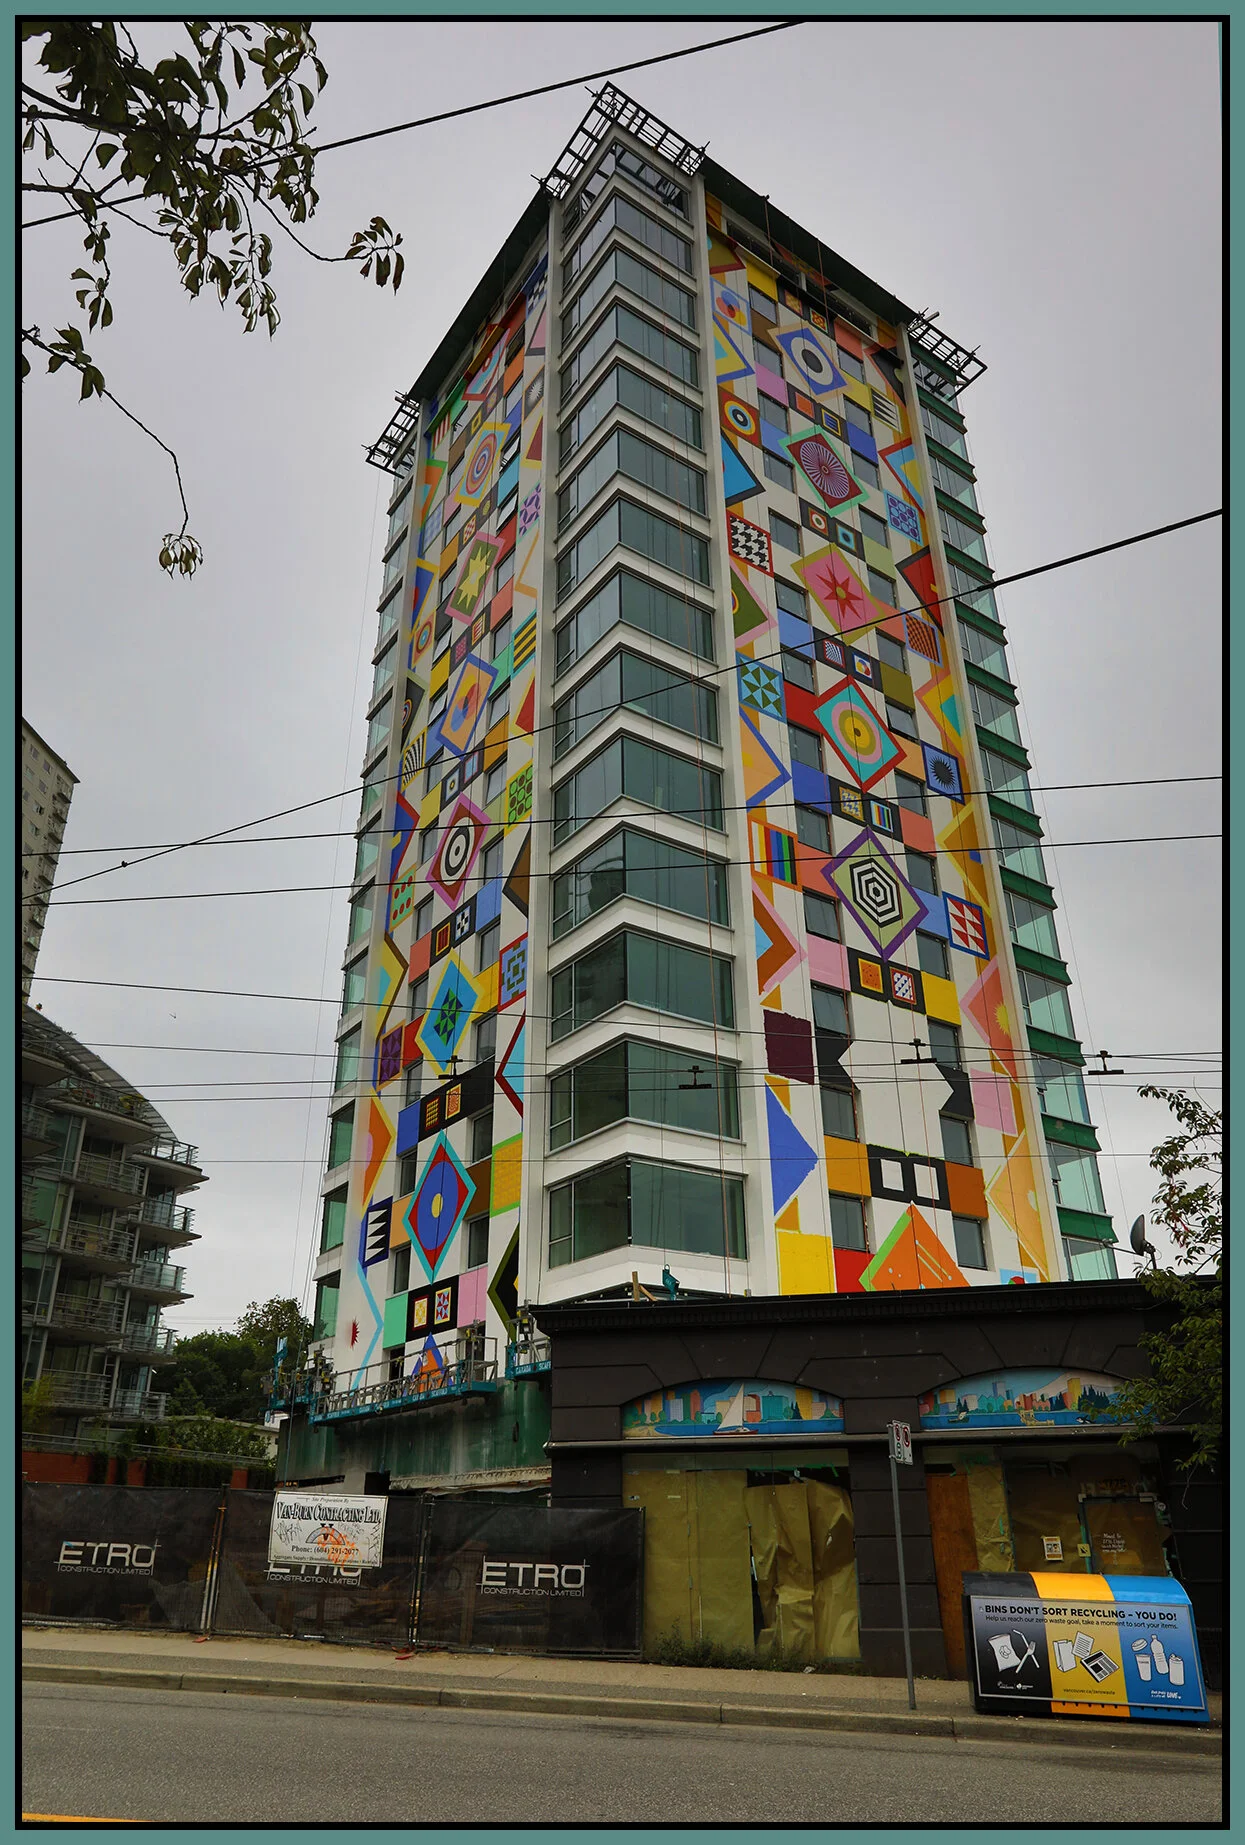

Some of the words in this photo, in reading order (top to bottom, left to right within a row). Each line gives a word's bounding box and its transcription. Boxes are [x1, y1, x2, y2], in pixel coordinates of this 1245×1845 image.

[59, 1541, 155, 1567] ETRO
[291, 1545, 313, 1553] Phone:
[60, 1565, 121, 1575] CONSTRUCTION
[481, 1561, 586, 1589] ETRO
[269, 1573, 328, 1584] CONSTRUCTION
[328, 1577, 358, 1585] LIMITED
[484, 1587, 549, 1596] CONSTRUCTION
[550, 1589, 581, 1597] LIMITED
[985, 1605, 1008, 1614] BINS
[1009, 1606, 1040, 1615] DON'T
[1042, 1607, 1068, 1616] SORT
[1070, 1608, 1126, 1619] RECYCLING
[1135, 1611, 1156, 1620] YOU
[1158, 1612, 1177, 1621] DO!
[1066, 1618, 1081, 1626] goal,
